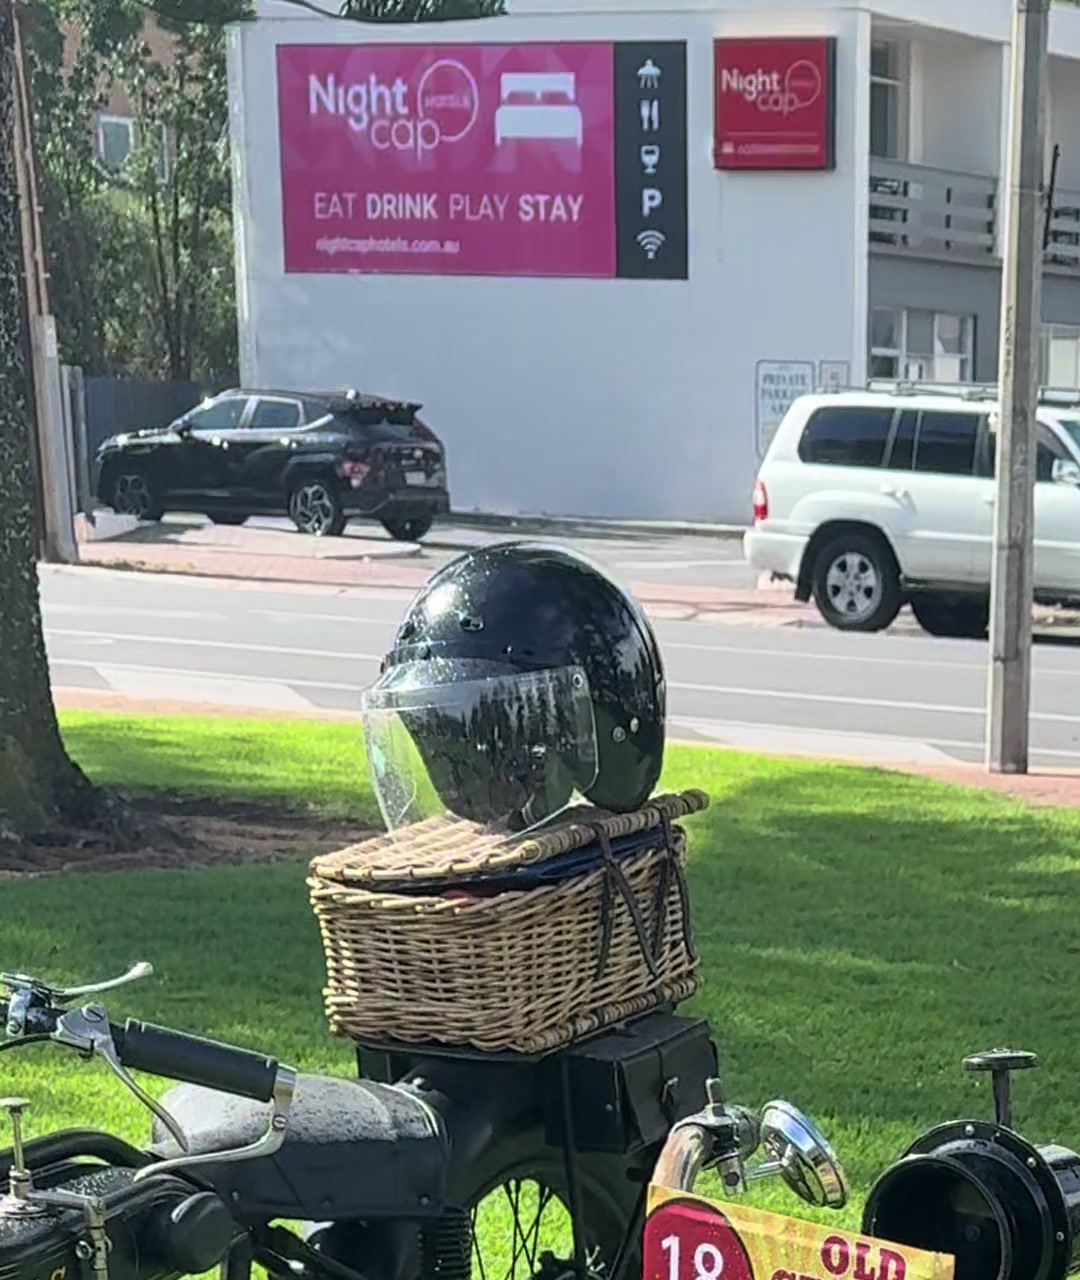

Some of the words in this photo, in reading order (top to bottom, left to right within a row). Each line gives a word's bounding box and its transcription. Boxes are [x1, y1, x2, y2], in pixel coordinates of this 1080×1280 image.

[722, 67, 780, 102] Night
[308, 72, 408, 131] Night
[757, 92, 800, 118] cap
[370, 119, 441, 161] cap
[314, 192, 358, 219] EAT
[366, 193, 438, 219] DRINK
[449, 193, 510, 220] PLAY
[518, 193, 584, 221] STAY
[643, 188, 661, 216] P
